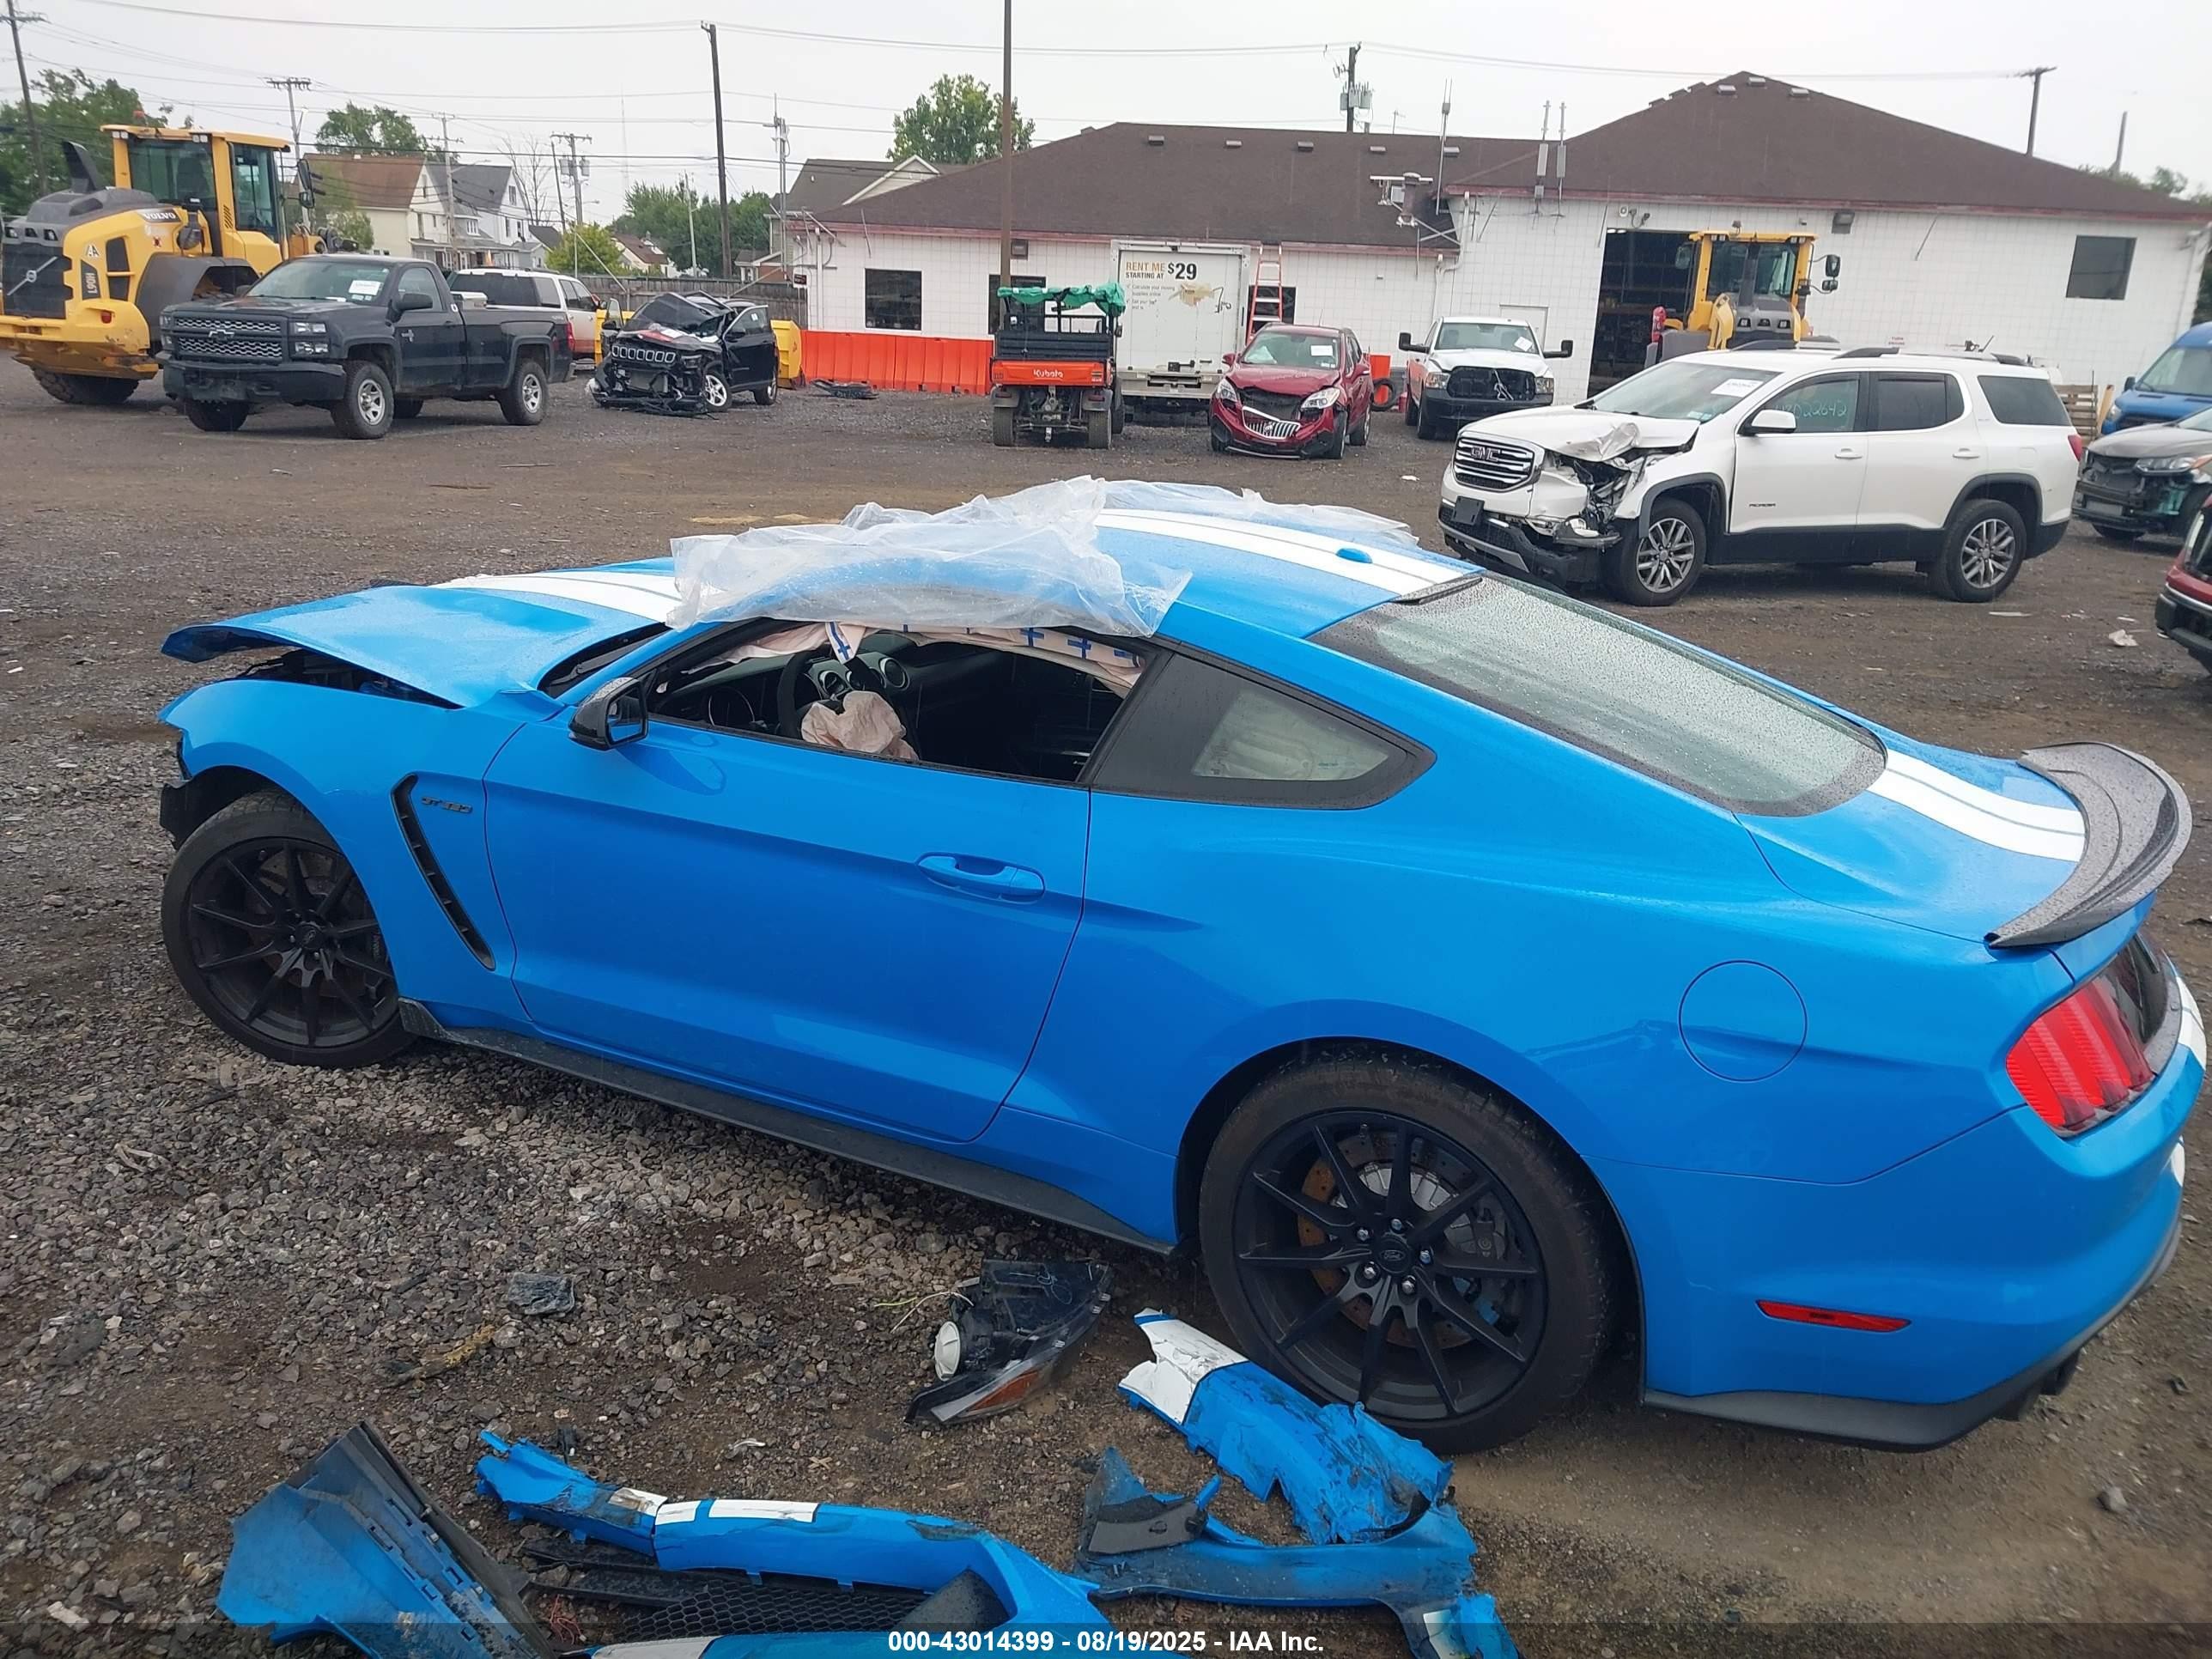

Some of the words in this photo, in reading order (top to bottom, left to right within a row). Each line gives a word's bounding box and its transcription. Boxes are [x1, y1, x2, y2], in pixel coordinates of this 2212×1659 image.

[1126, 262, 1149, 271] RENT
[1152, 263, 1165, 271] ME
[1168, 262, 1197, 280] $29
[1033, 369, 1063, 378] Kubota
[1471, 447, 1500, 462] GMC
